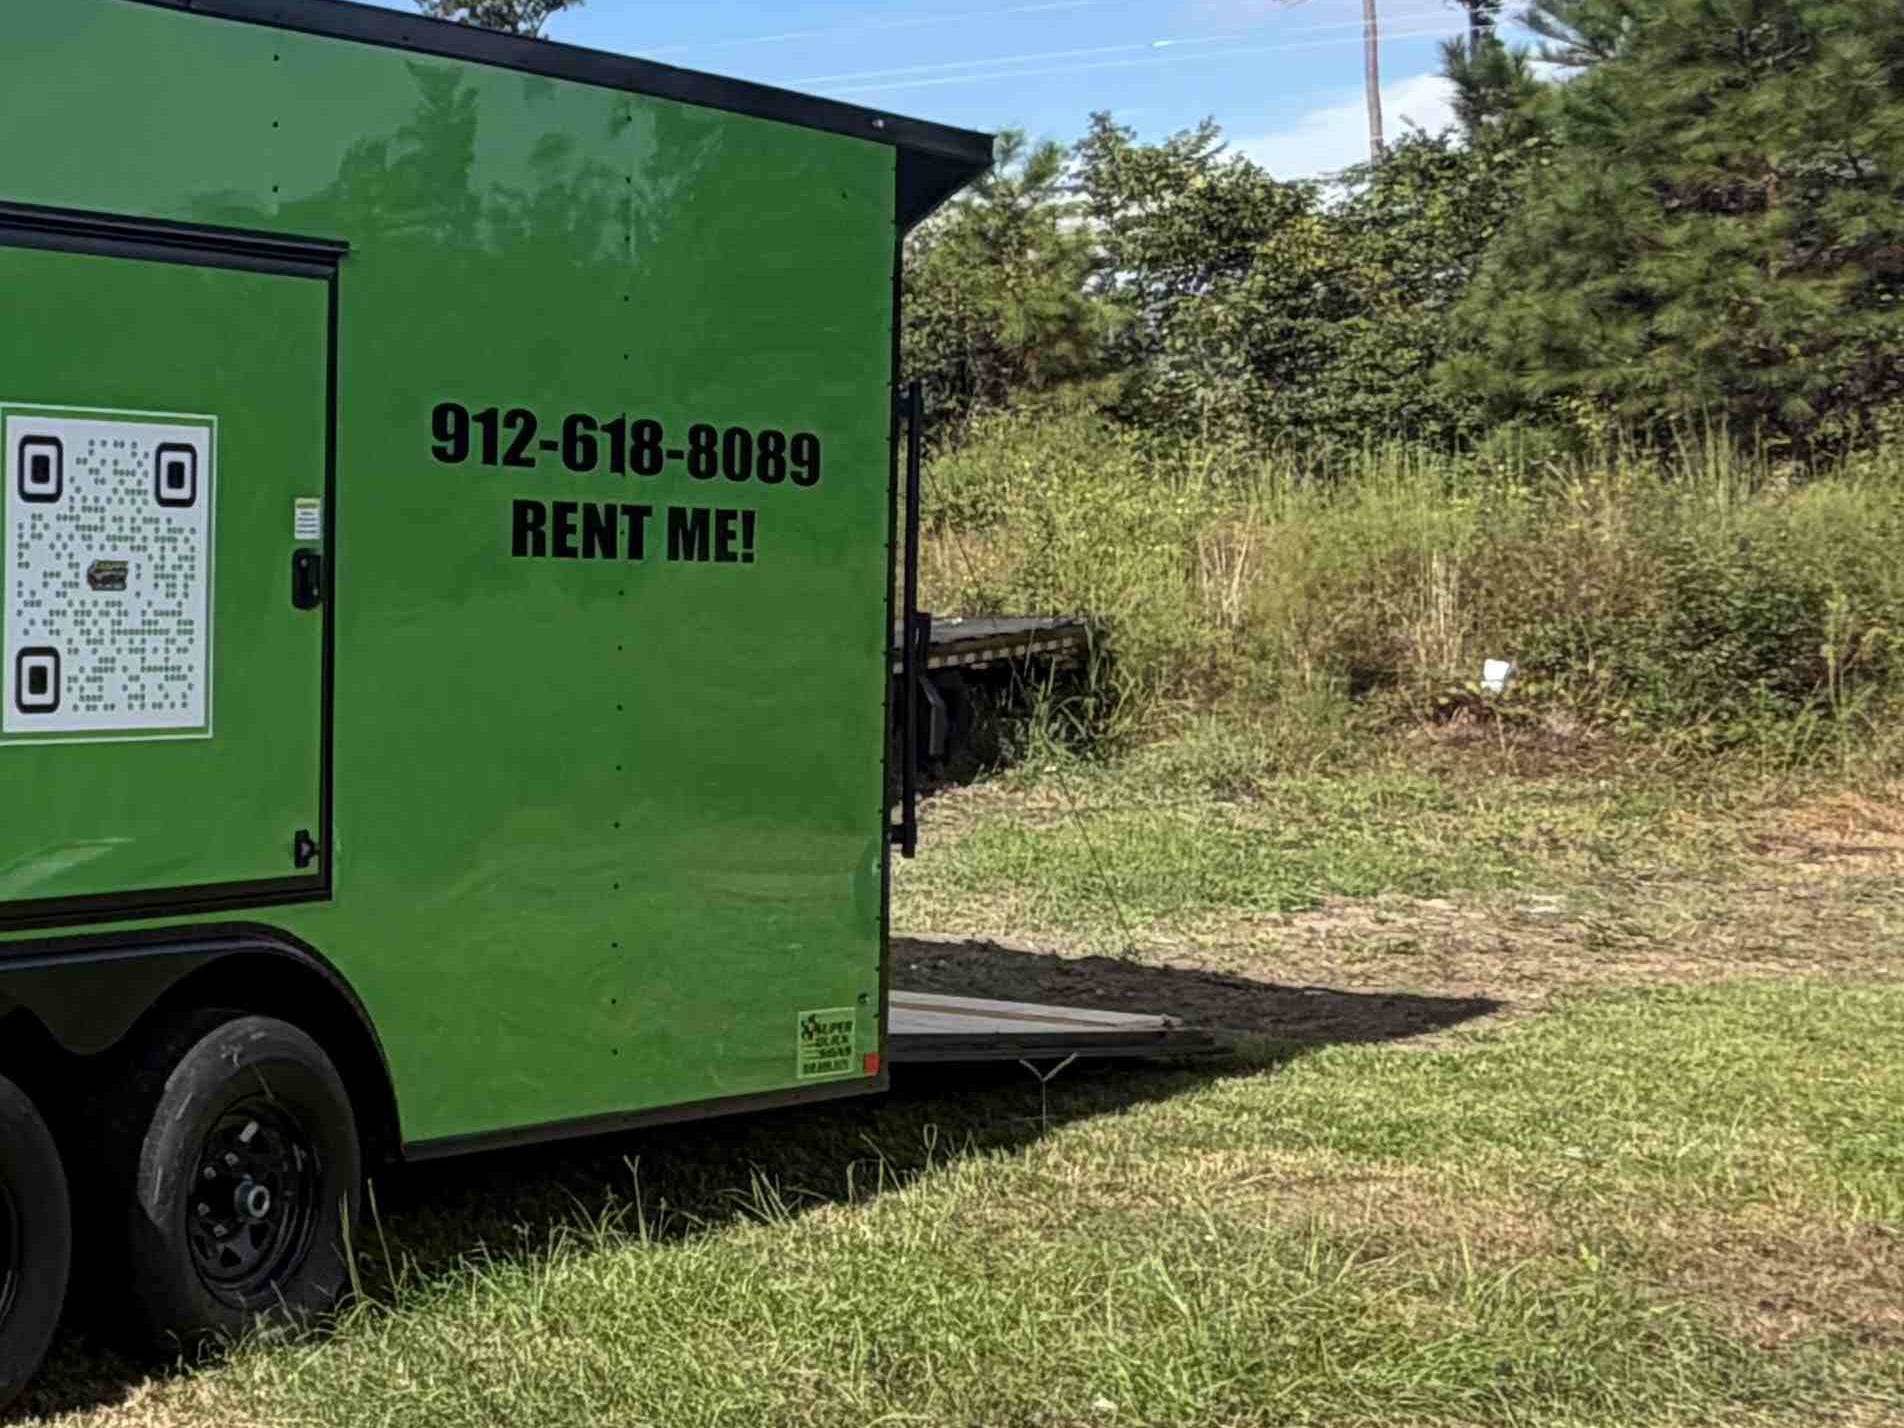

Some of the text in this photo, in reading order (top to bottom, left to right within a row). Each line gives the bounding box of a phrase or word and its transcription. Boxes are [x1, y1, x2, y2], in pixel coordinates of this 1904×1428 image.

[431, 402, 822, 487] 912-618-8089
[512, 499, 756, 563] RENT ME!
